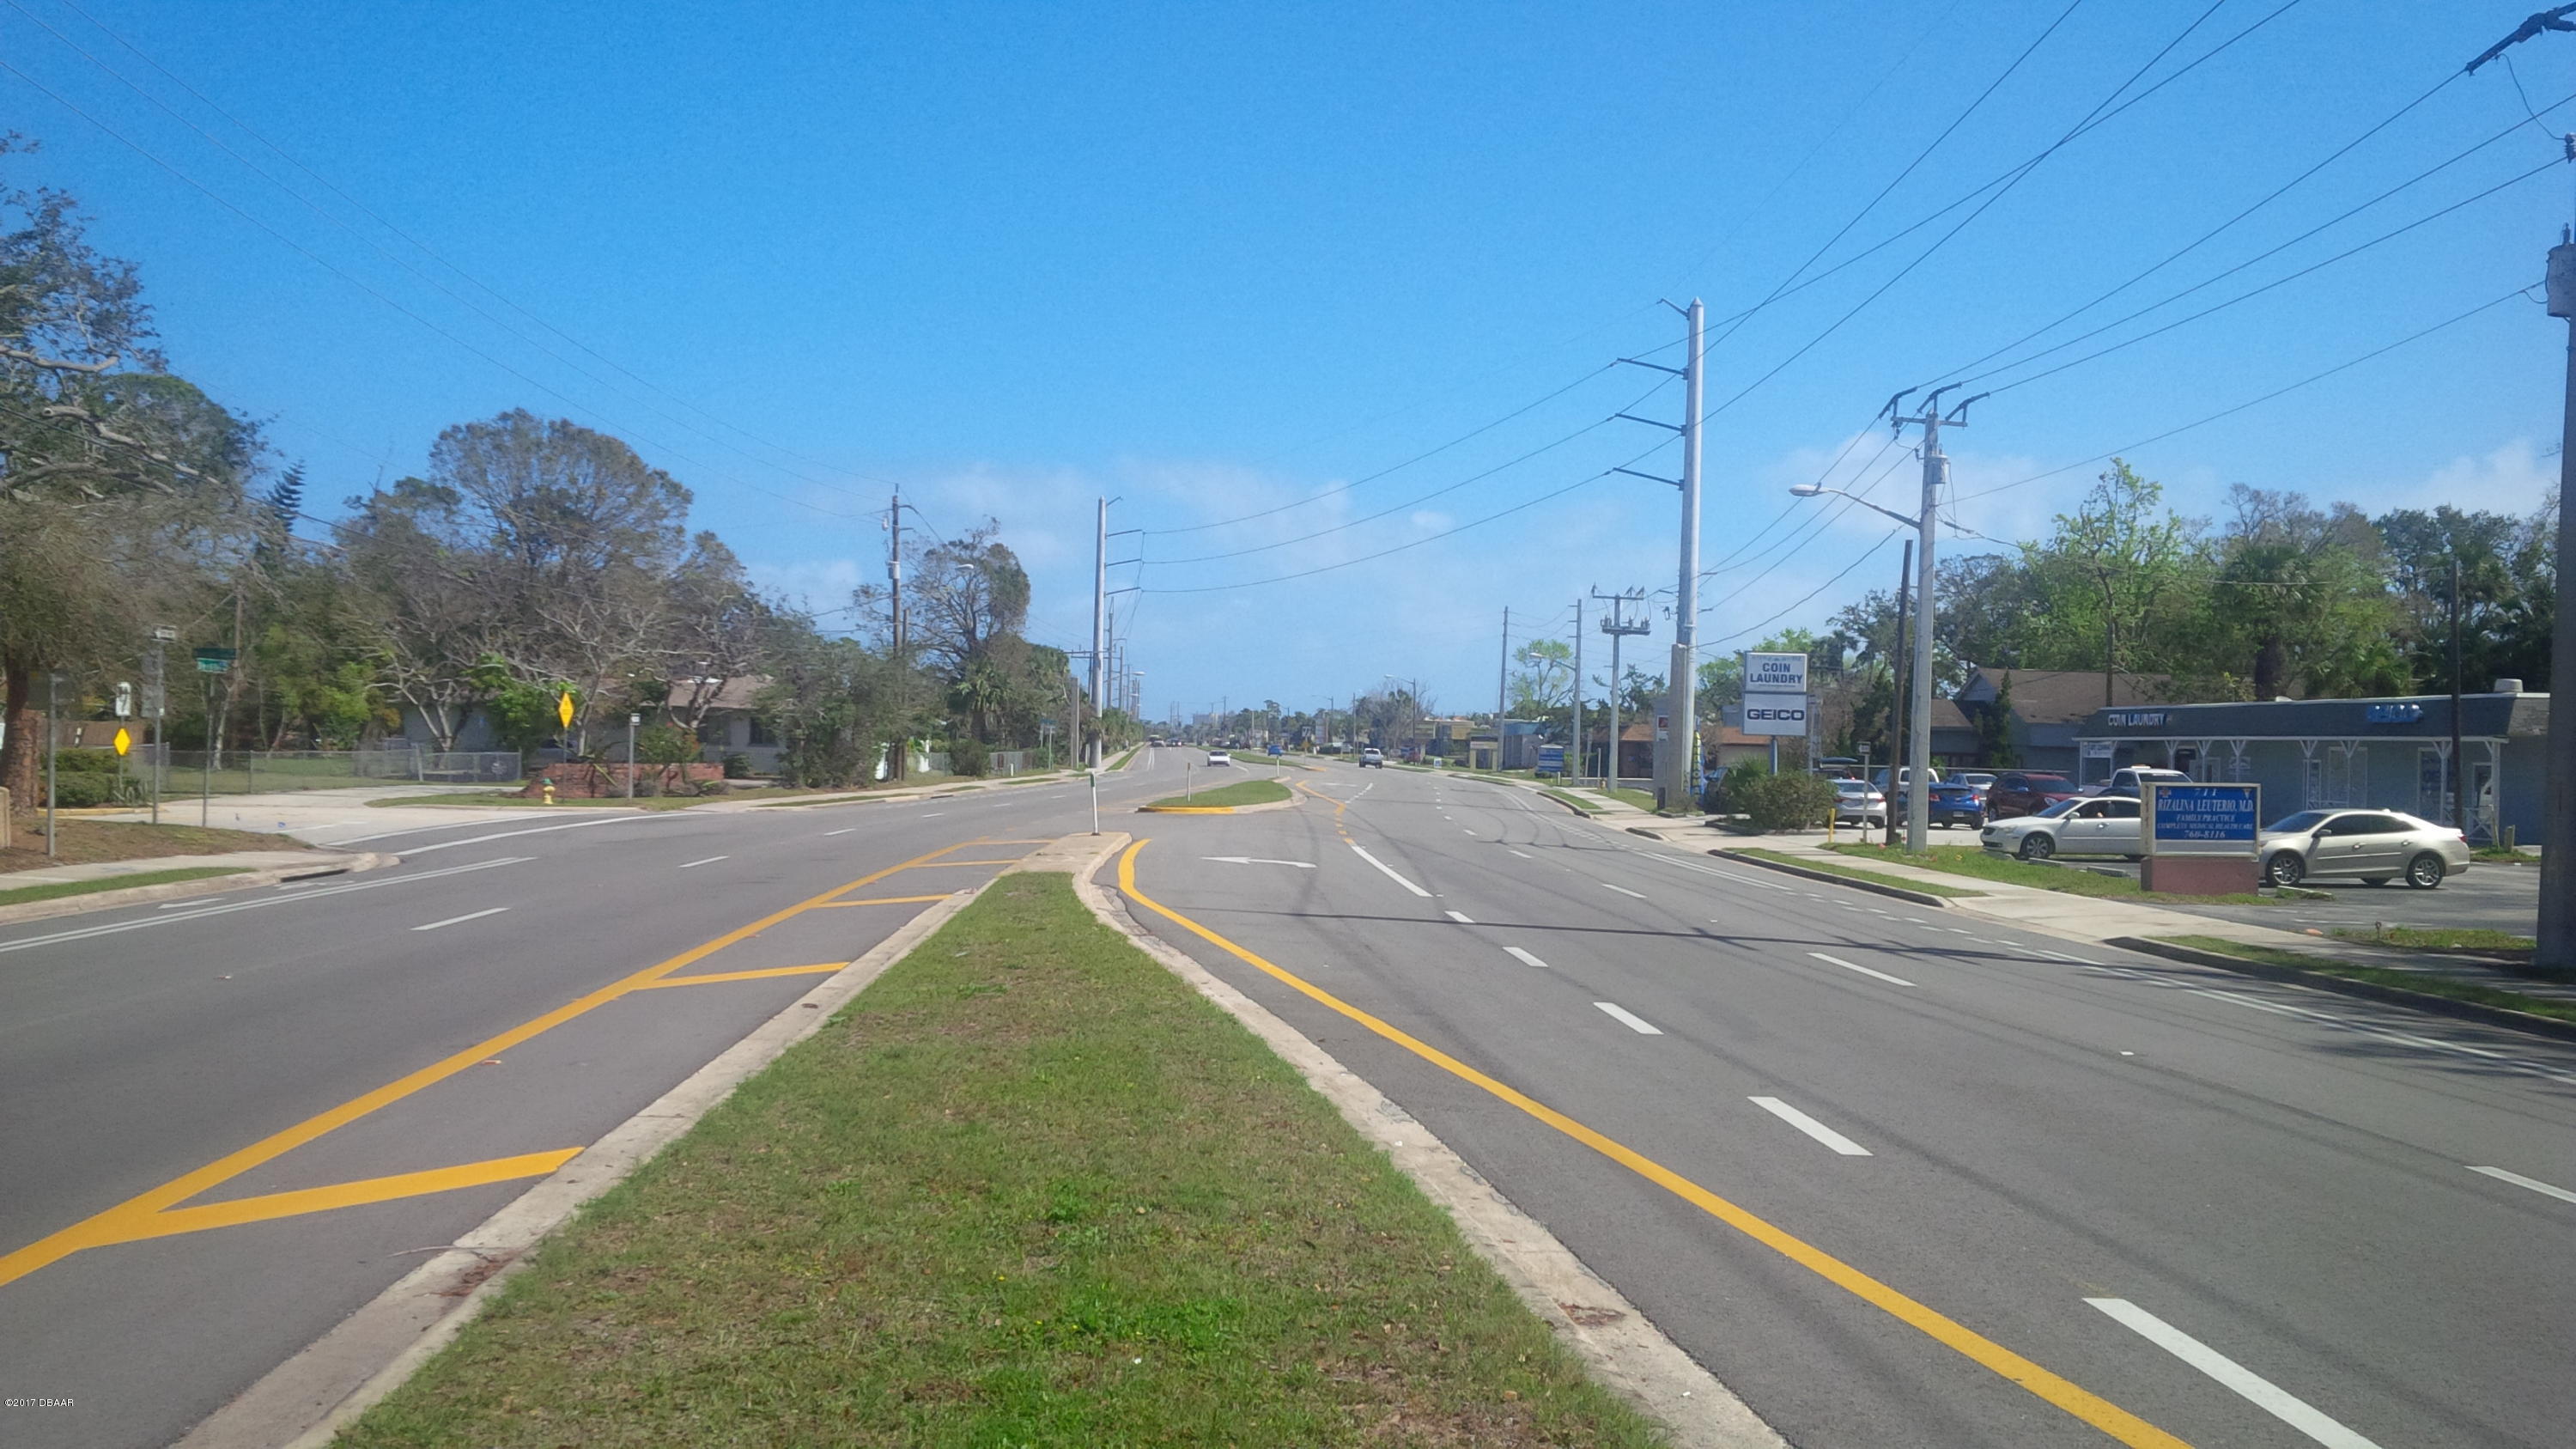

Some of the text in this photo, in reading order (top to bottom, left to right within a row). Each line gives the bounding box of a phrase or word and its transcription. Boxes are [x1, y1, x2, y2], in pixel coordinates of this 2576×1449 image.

[1762, 662, 1790, 673] COIN
[1750, 673, 1802, 684] LAUNDRY
[1747, 709, 1805, 721] GEICO
[2108, 712, 2165, 727] COIN LAUNDRY
[2158, 799, 2194, 812] RIZALINA
[2239, 800, 2254, 813] M.D.
[2202, 813, 2236, 822] PRACTICE
